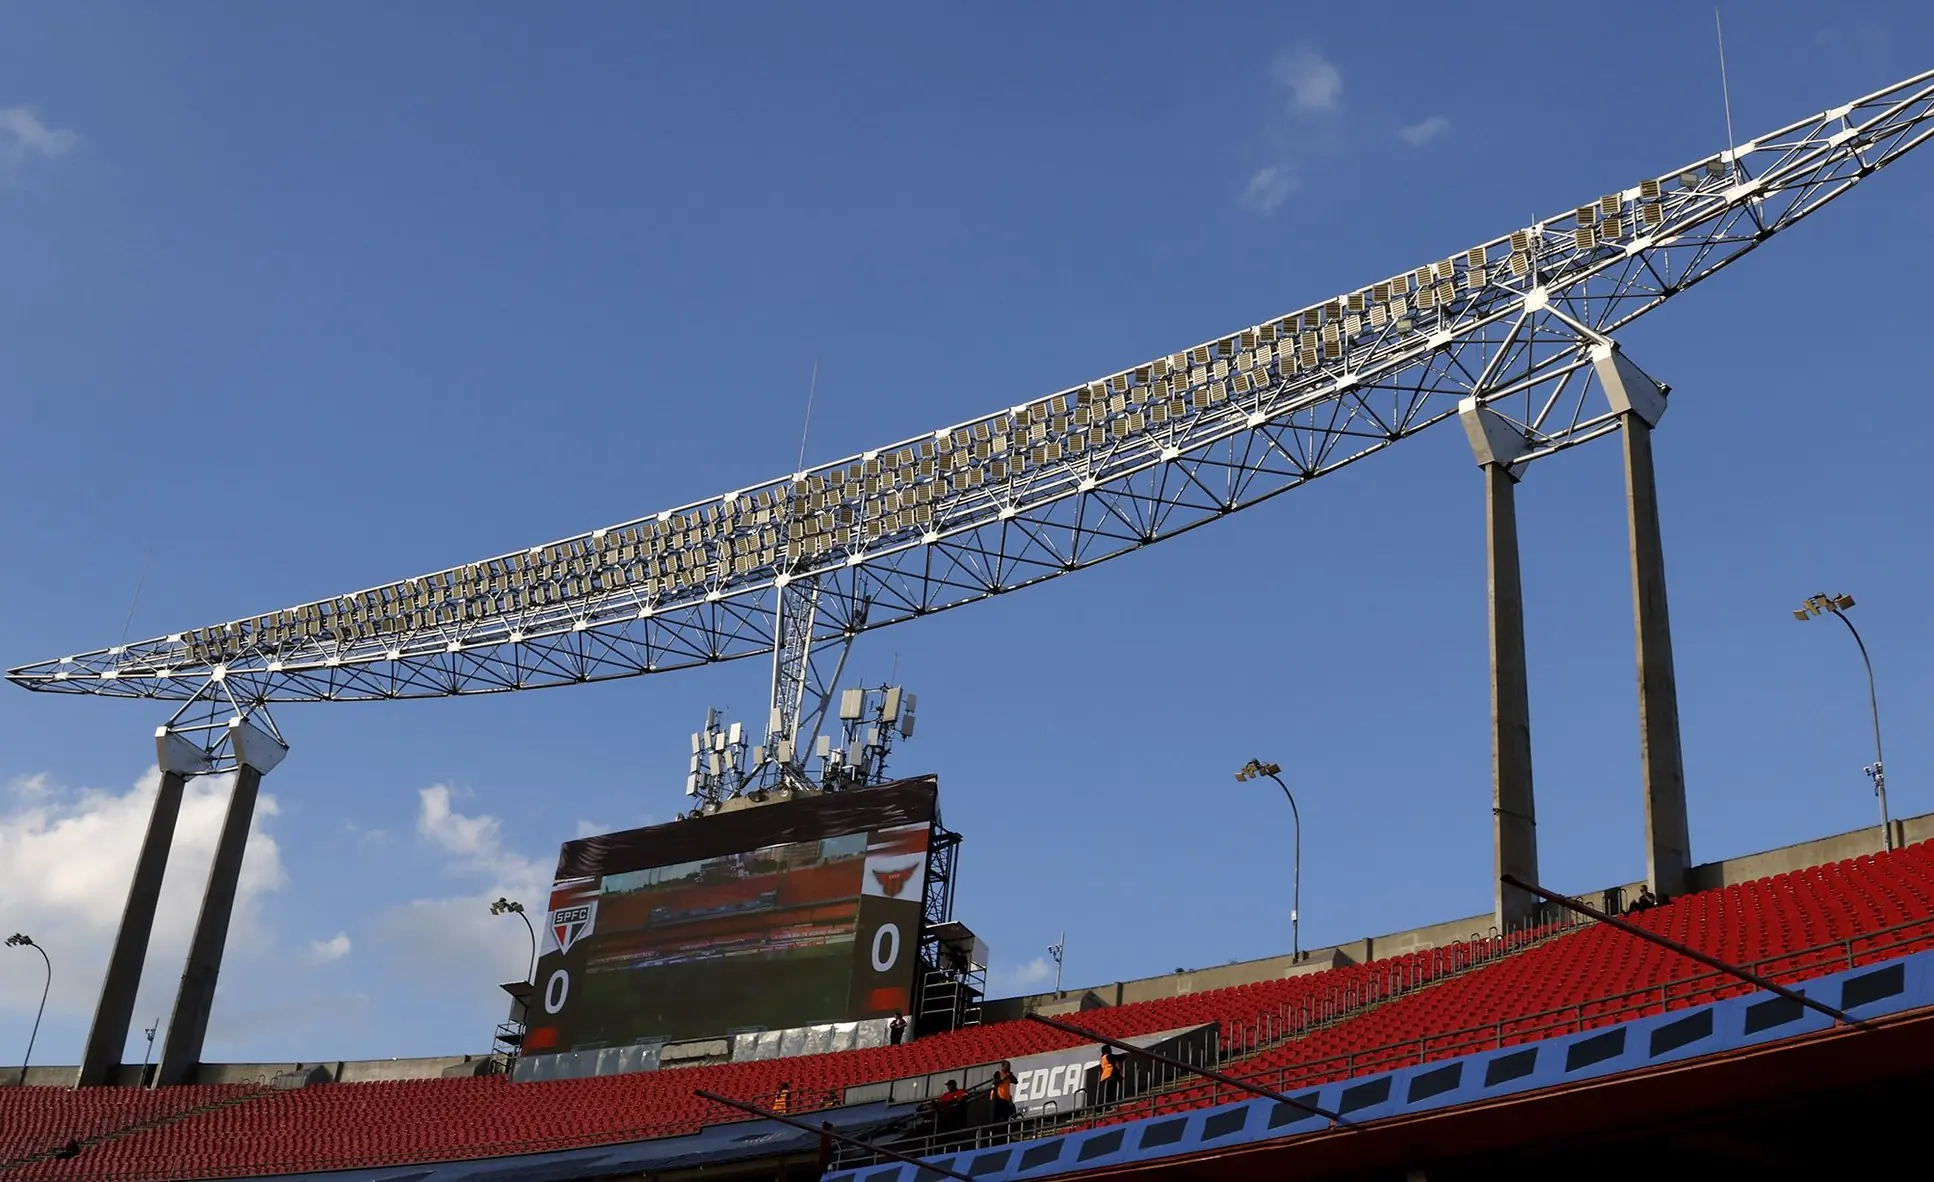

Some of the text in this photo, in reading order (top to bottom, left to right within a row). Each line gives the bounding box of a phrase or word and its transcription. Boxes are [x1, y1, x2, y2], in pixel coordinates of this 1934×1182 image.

[555, 909, 587, 923] SPFC
[871, 922, 900, 972] 0
[544, 969, 569, 1014] 0
